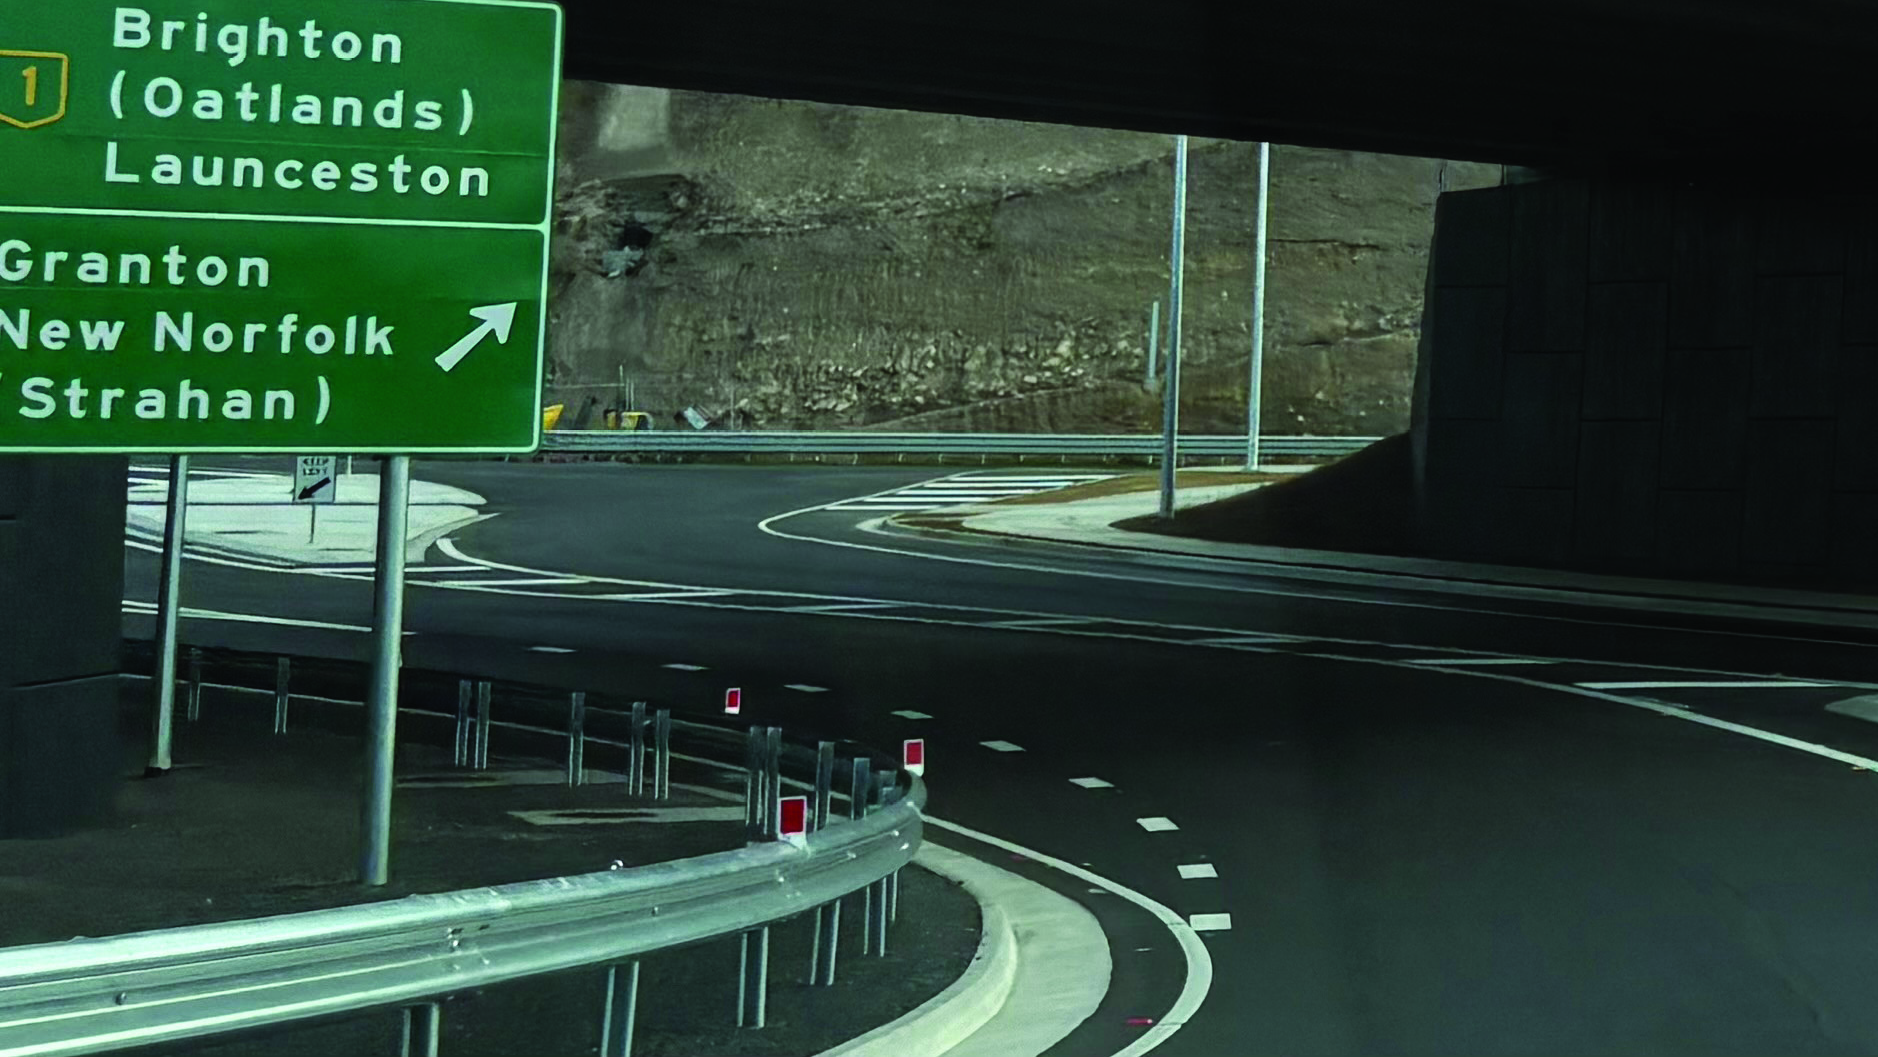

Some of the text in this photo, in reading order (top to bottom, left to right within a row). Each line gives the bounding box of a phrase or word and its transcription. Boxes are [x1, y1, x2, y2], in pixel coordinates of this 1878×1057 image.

[113, 7, 402, 67] Brighton
[22, 66, 37, 106] 1
[110, 70, 473, 136] (Oatlands)
[105, 141, 489, 197] Launceston
[0, 239, 270, 287] Granton
[0, 309, 395, 356] New Norfolk
[0, 372, 331, 424] Strahan)
